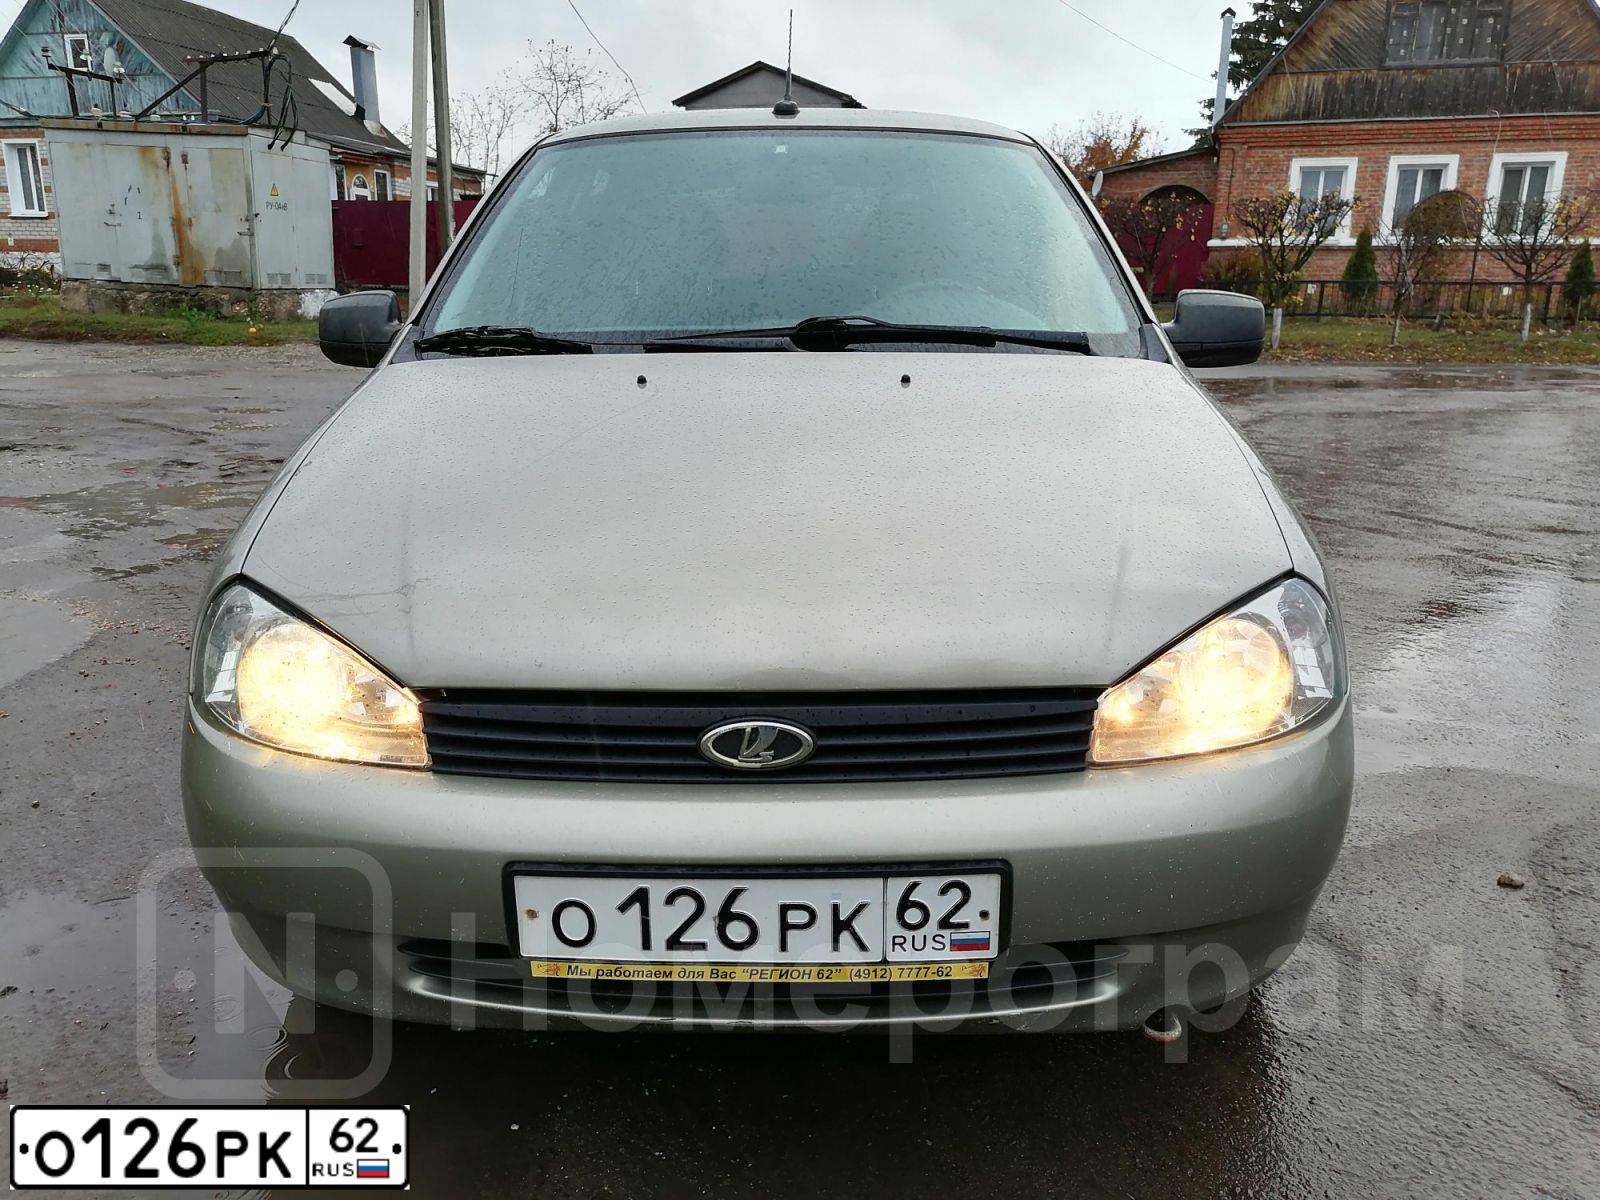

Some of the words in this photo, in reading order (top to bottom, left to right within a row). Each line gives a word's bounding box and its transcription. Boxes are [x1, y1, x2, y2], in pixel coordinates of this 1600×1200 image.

[894, 880, 972, 932] 62
[891, 933, 947, 953] RUS
[566, 965, 591, 977] Мы
[595, 966, 674, 980] работаем
[677, 968, 705, 980] для
[709, 969, 737, 979] Вас
[849, 967, 893, 982] (4912)
[898, 966, 953, 978] 7777-62
